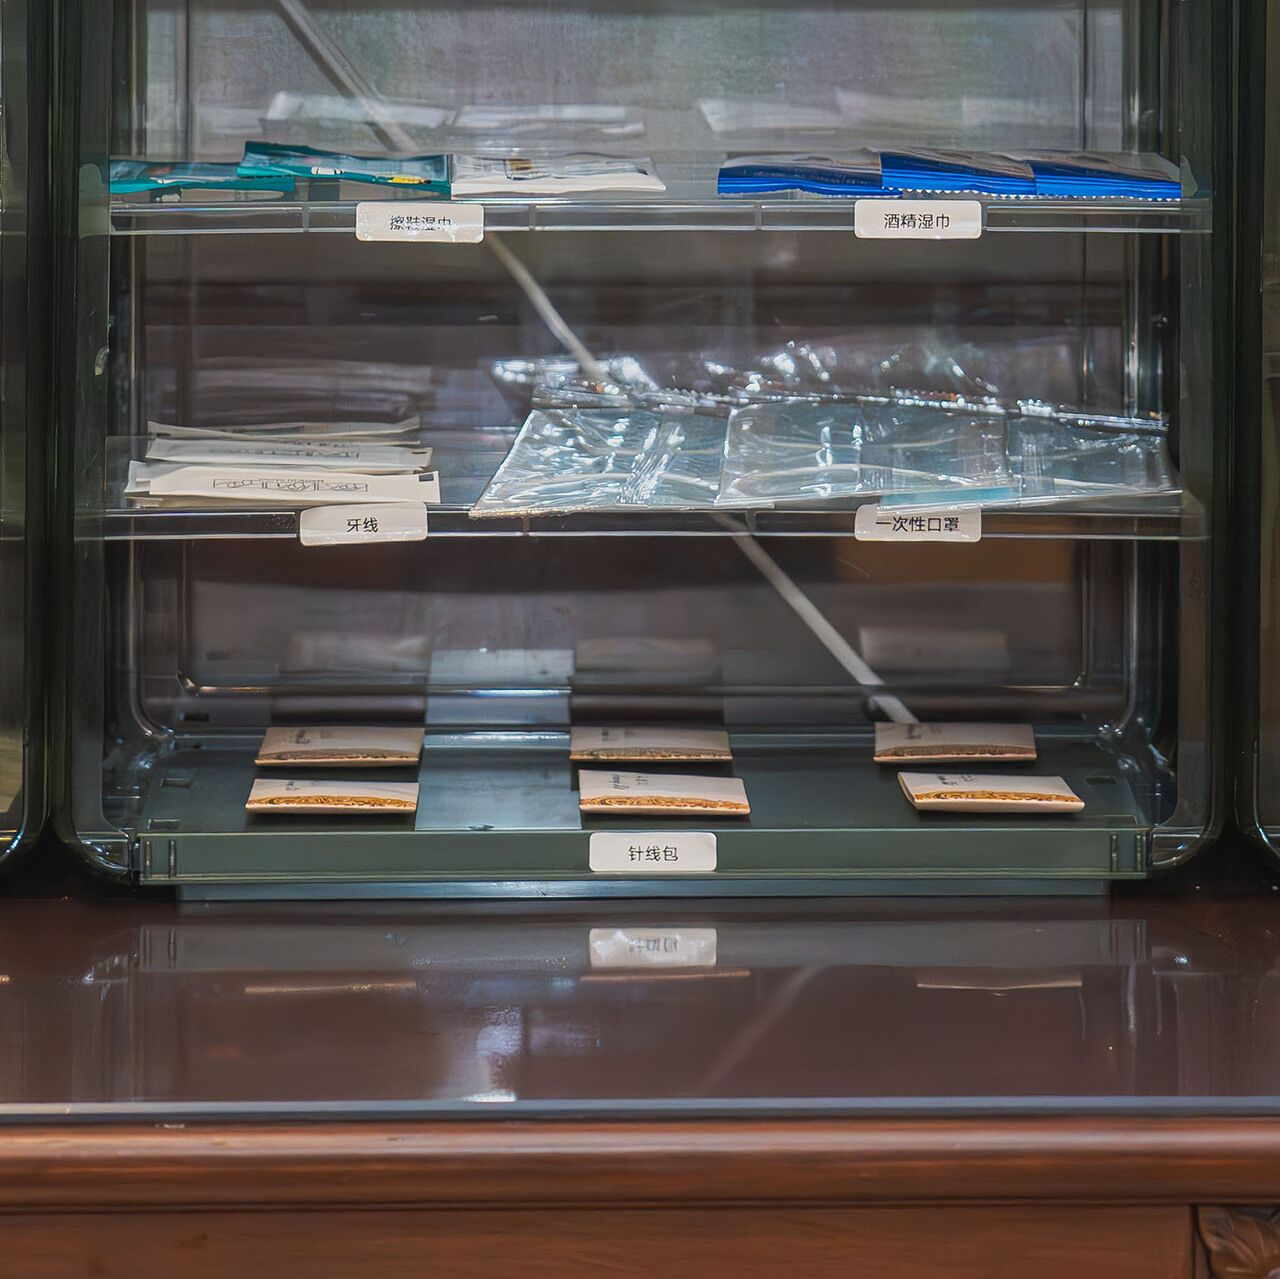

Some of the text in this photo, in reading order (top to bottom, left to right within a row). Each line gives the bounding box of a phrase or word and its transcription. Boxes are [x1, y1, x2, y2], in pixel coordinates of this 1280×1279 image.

[883, 213, 951, 230] 酒精湿巾
[346, 517, 379, 534] 牙线
[875, 516, 961, 532] 一次性口罩
[628, 845, 679, 862] 针线包
